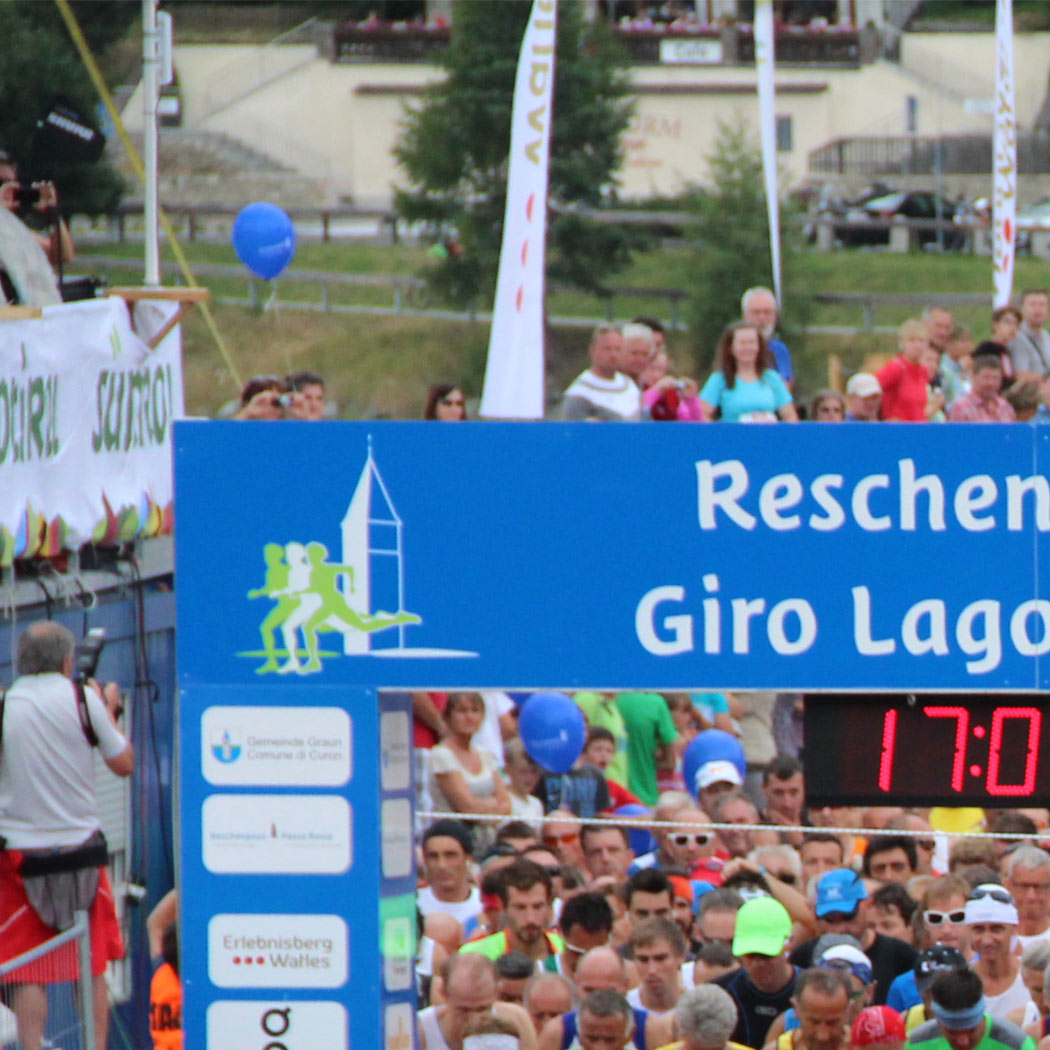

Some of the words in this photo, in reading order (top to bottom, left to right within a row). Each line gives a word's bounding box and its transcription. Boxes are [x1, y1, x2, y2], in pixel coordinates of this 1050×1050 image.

[636, 574, 818, 656] Giro
[222, 935, 333, 954] Erlebnisberg
[269, 954, 332, 969] Watles
